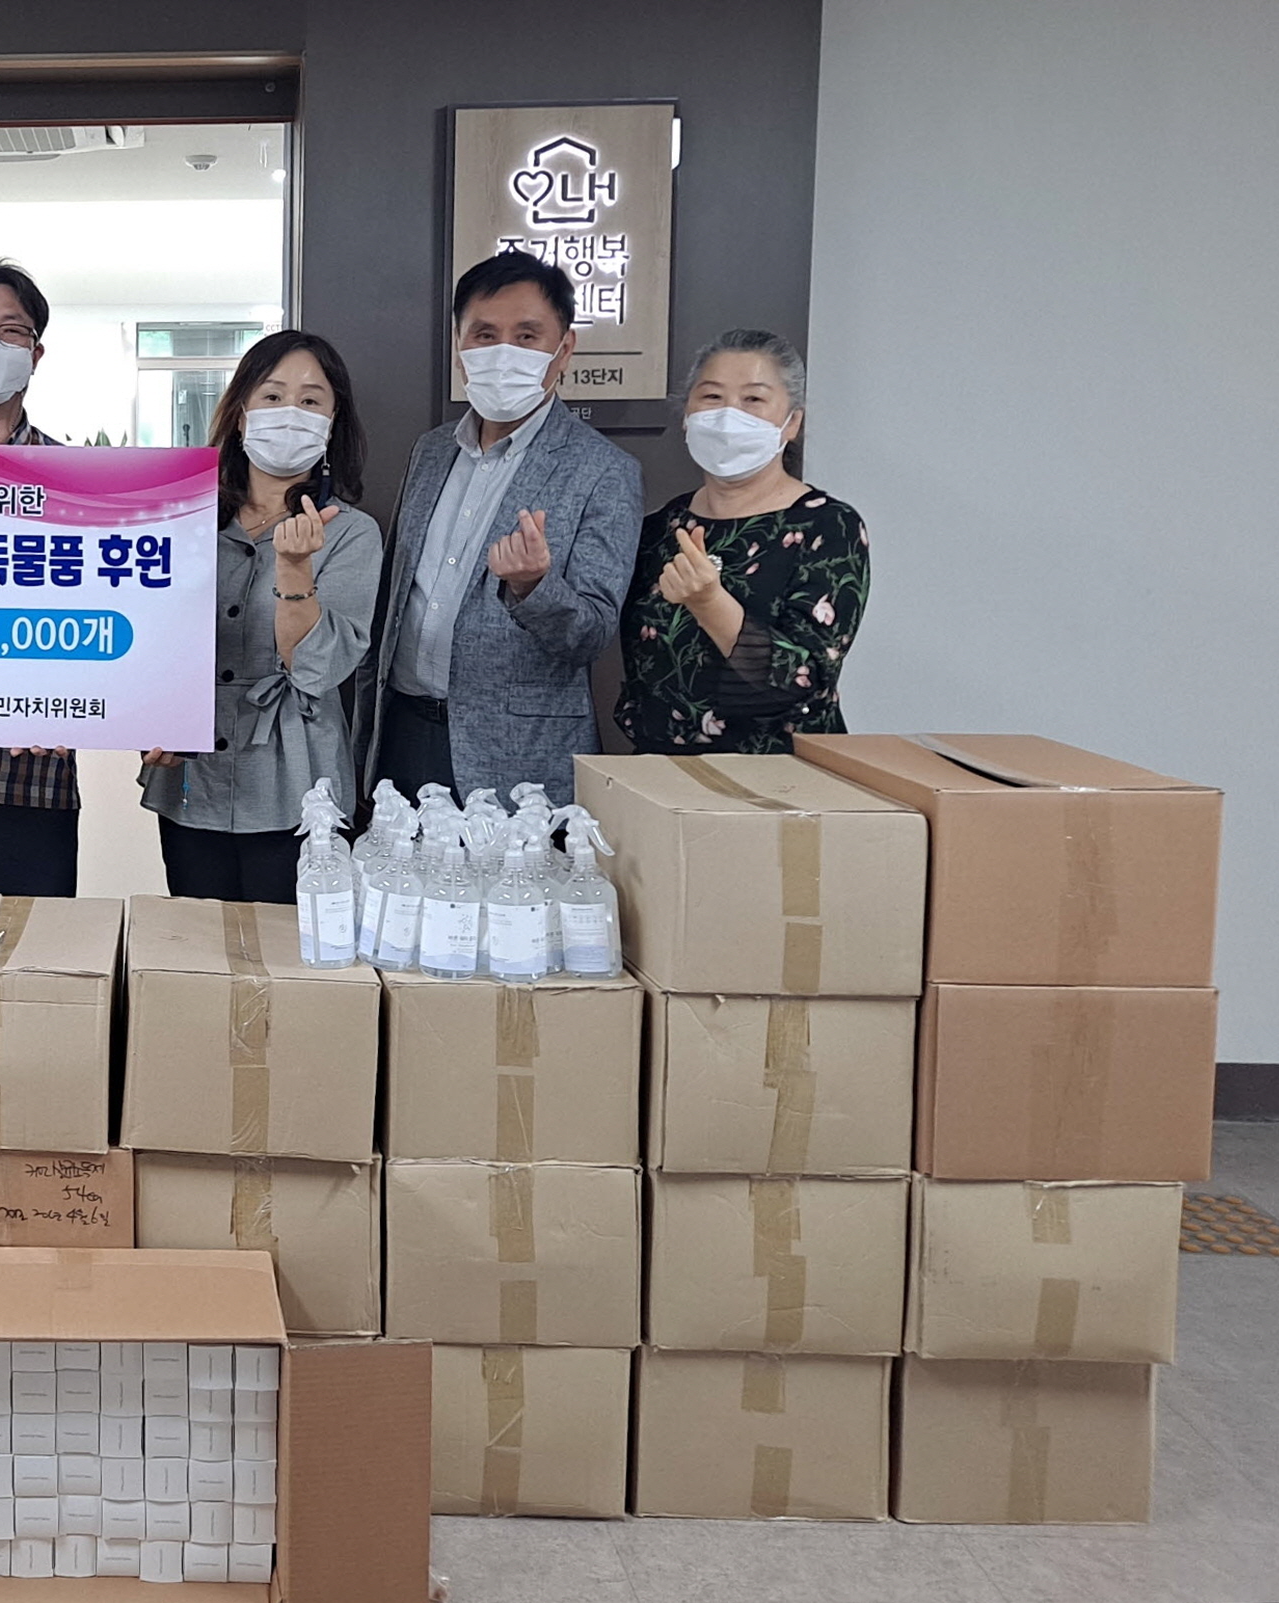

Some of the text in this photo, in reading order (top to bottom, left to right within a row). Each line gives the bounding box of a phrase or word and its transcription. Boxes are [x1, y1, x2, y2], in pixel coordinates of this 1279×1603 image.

[561, 171, 616, 202] LH
[572, 367, 623, 386] 13단지
[97, 533, 172, 589] 후원
